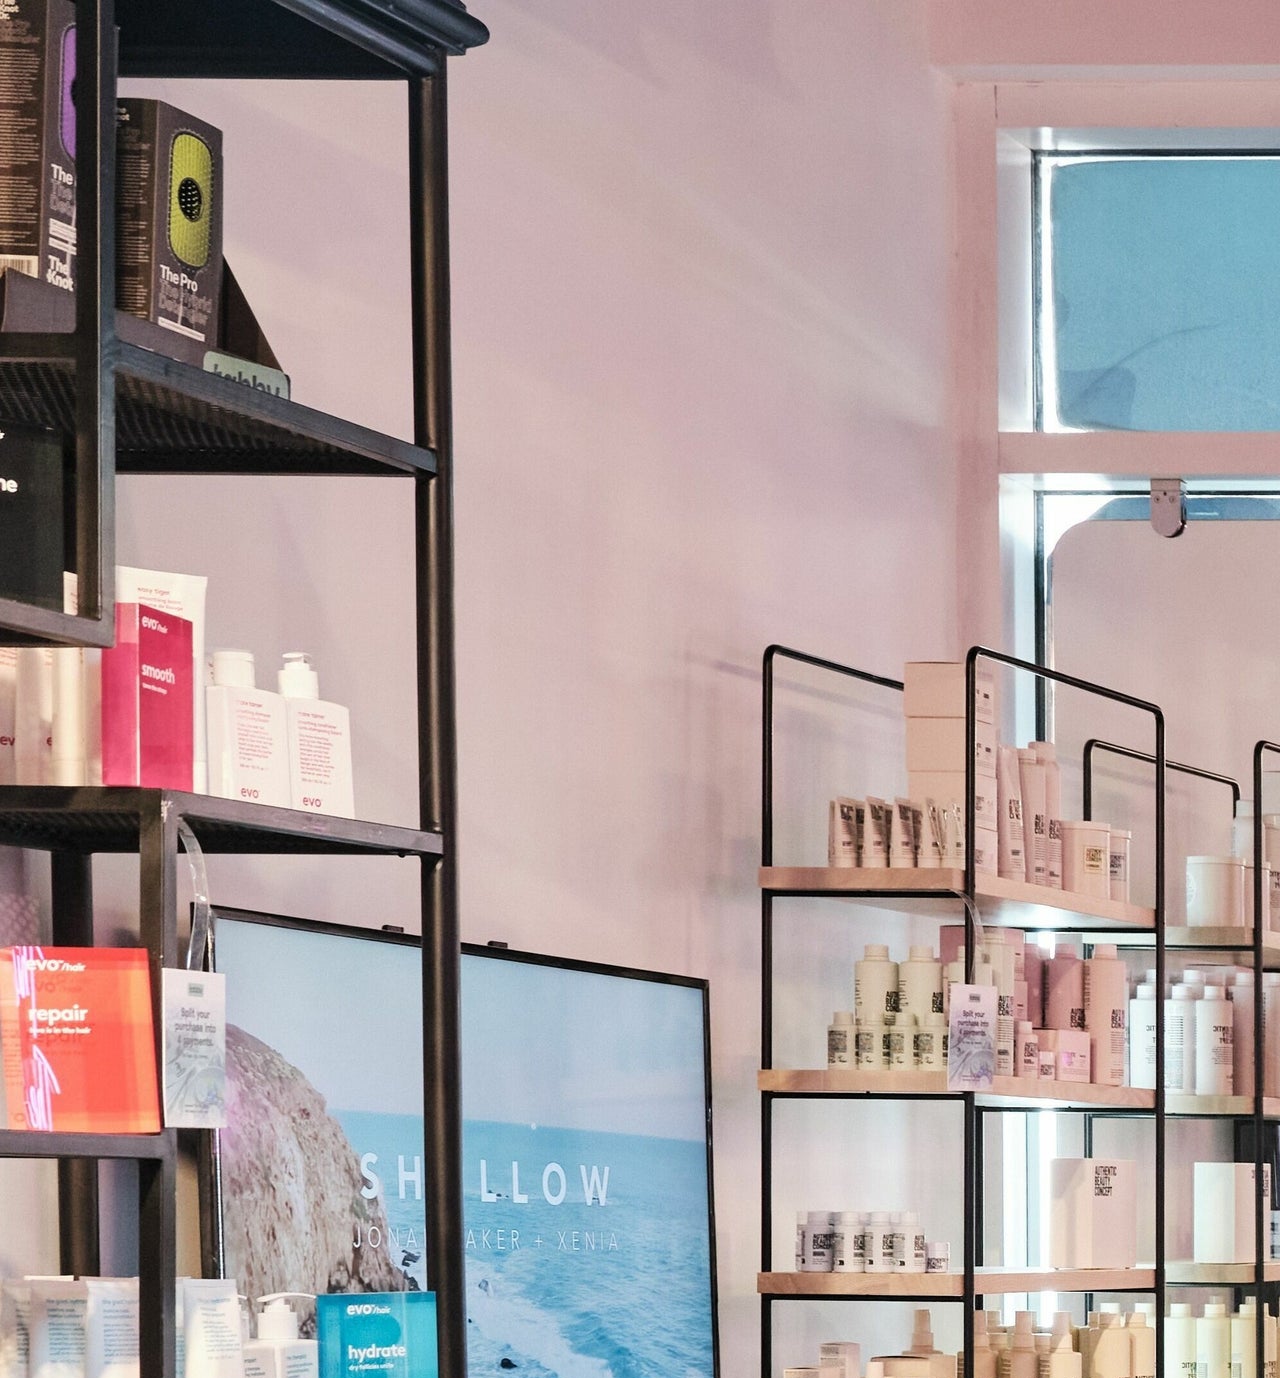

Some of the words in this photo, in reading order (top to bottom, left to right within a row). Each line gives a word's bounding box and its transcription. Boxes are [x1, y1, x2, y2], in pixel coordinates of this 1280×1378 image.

[51, 163, 74, 185] The
[160, 264, 180, 285] The
[180, 272, 199, 292] Pro
[141, 663, 176, 685] smooth
[241, 787, 259, 799] evo
[302, 796, 322, 808] evo
[28, 1003, 88, 1026] repair
[360, 1152, 611, 1207] SHLLOW
[557, 1231, 619, 1251] XENIA
[348, 1343, 407, 1363] hydrate
